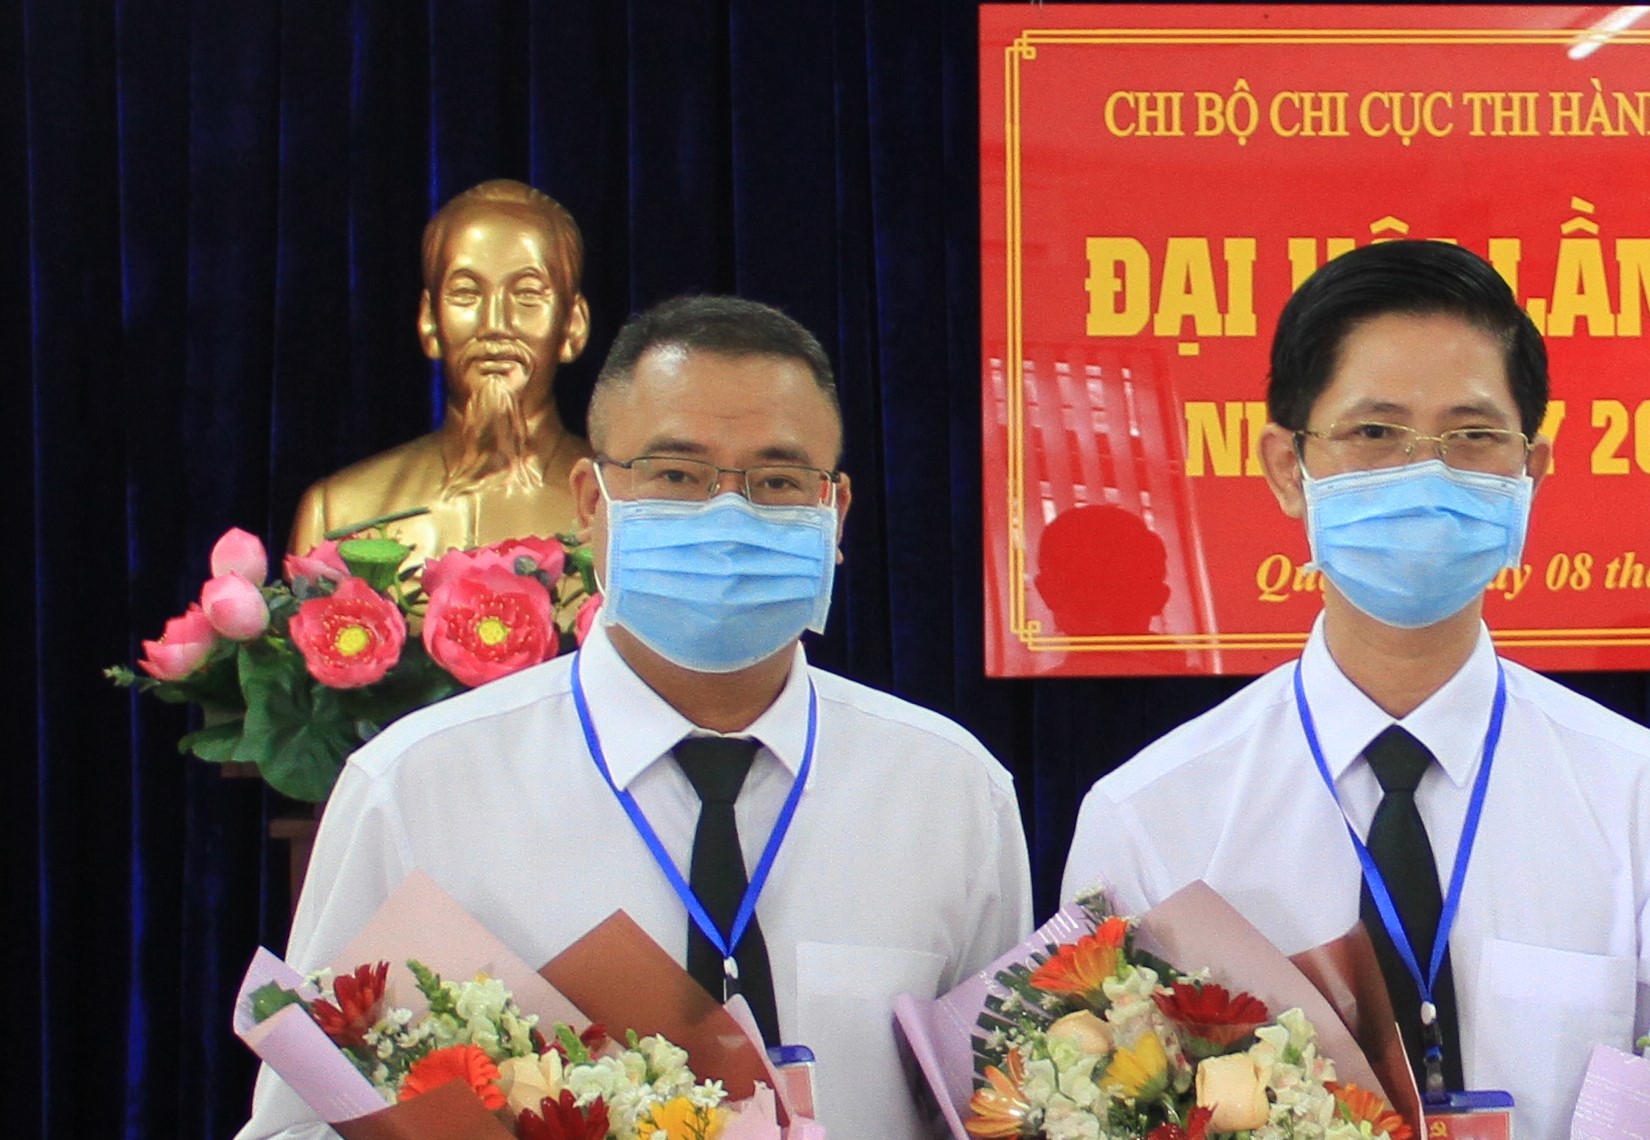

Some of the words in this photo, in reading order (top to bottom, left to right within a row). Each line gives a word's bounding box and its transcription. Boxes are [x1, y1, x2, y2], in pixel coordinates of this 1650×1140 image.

[1104, 91, 1185, 138] CHI
[1194, 78, 1260, 145] BỘ
[1269, 91, 1349, 138] CHI
[1359, 91, 1454, 146] CỤC
[1462, 91, 1540, 137] THI
[1084, 237, 1258, 357] ĐẠI
[1546, 553, 1594, 591] 08
